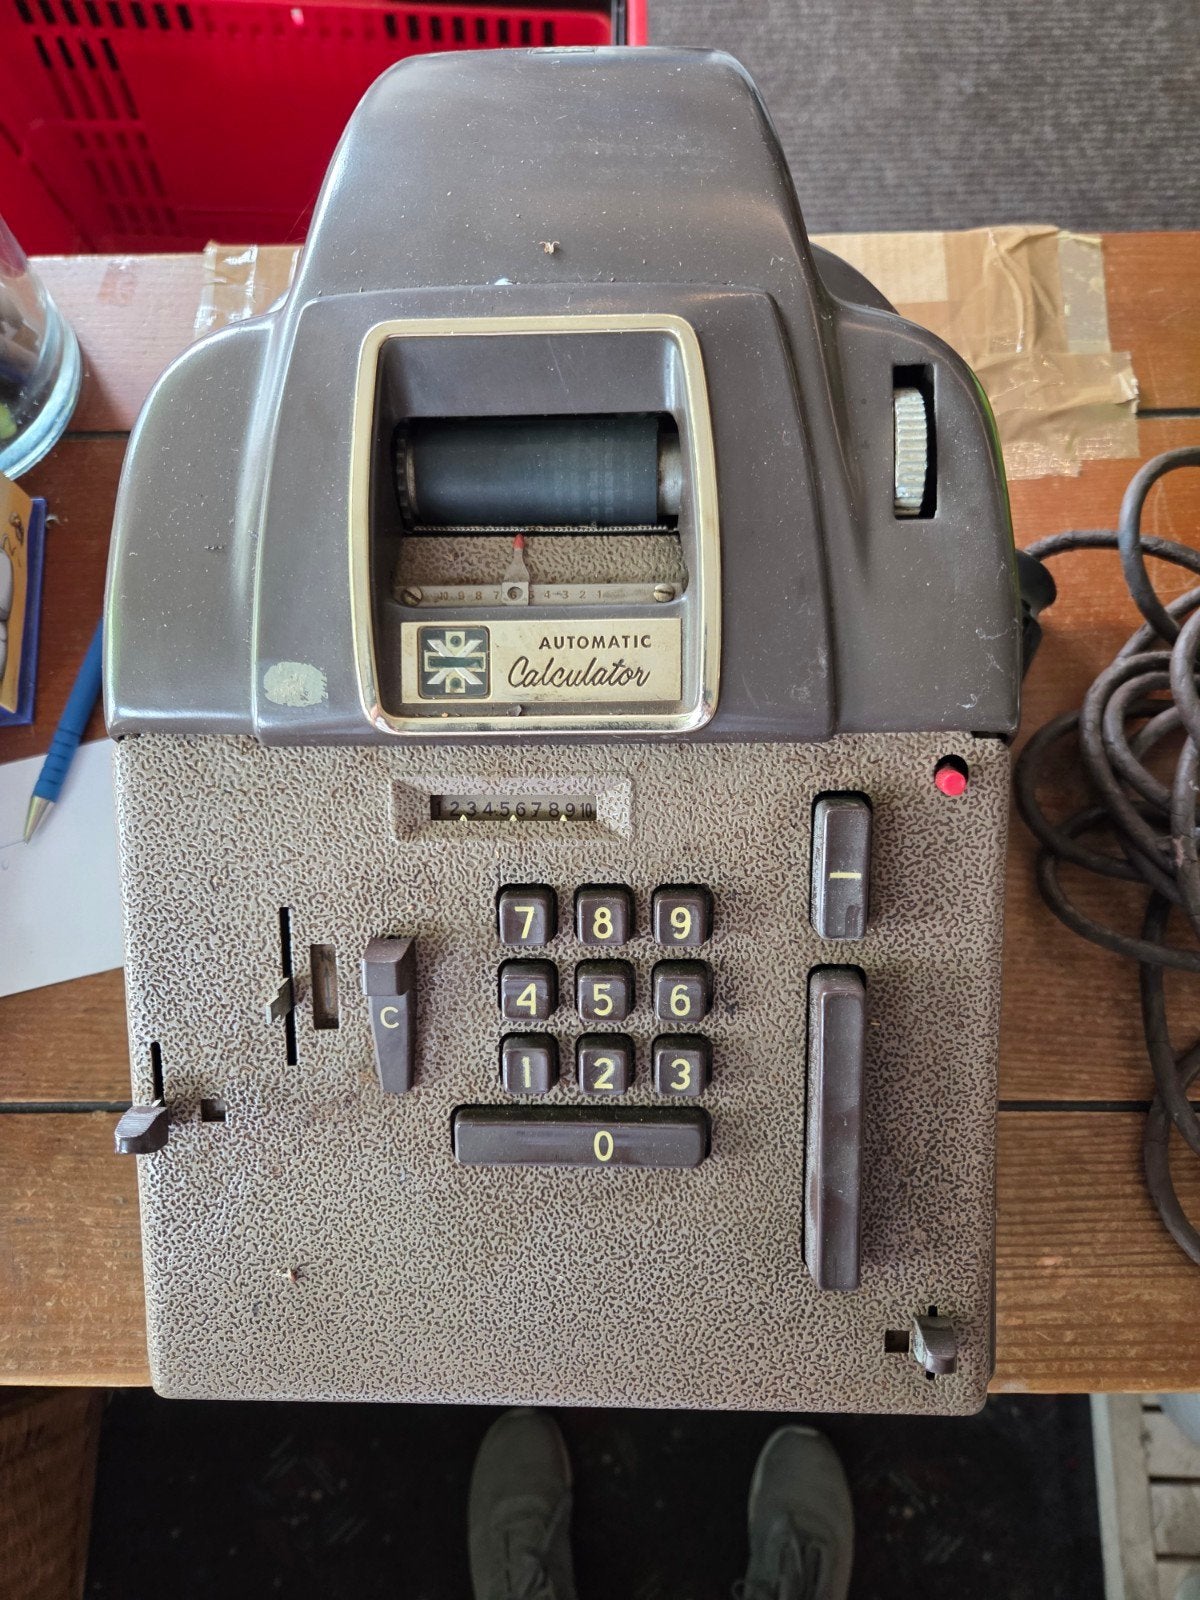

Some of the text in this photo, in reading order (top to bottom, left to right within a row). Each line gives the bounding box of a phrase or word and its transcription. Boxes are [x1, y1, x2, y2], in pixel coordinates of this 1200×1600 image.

[538, 634, 651, 650] AUTOMATIC
[507, 655, 651, 688] Calculator
[514, 906, 692, 940] 7 8 9
[516, 983, 691, 1017] 4 5 6
[380, 1006, 399, 1029] C
[522, 1056, 691, 1091] 1 2 3
[593, 1130, 614, 1162] 0
